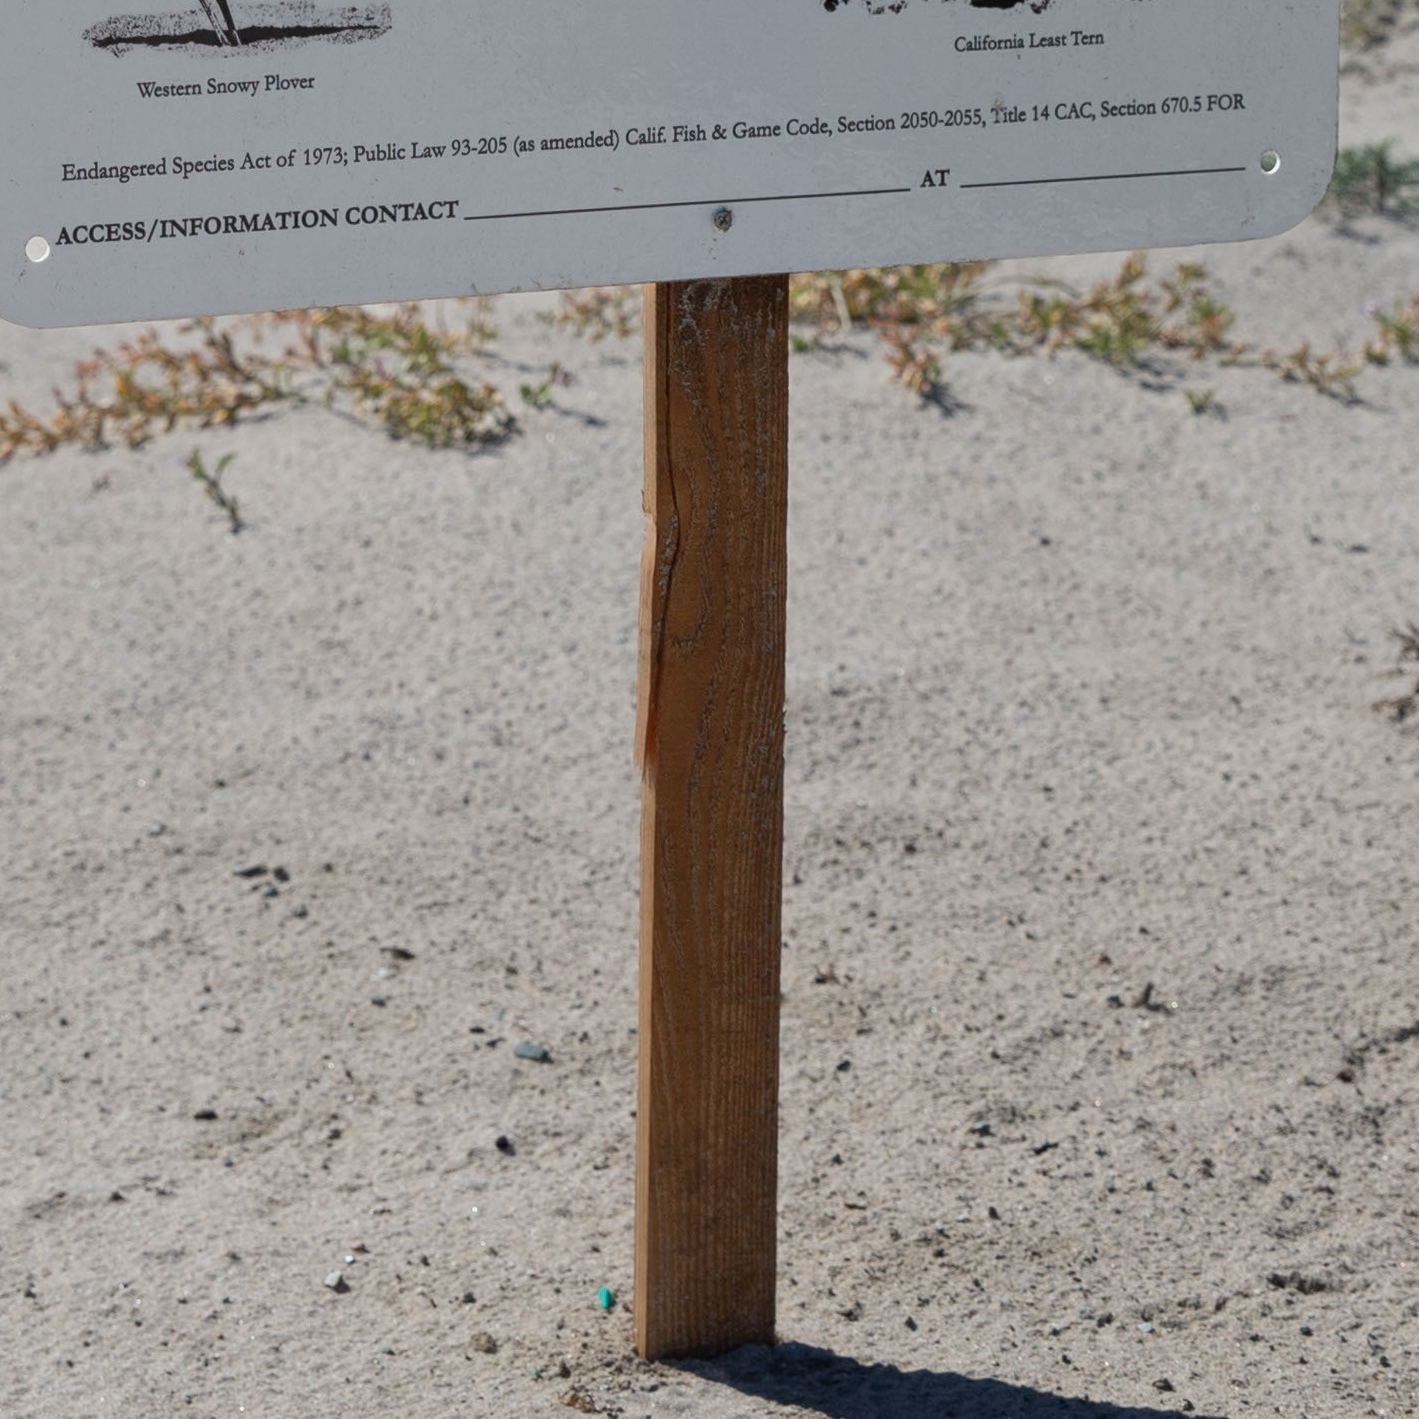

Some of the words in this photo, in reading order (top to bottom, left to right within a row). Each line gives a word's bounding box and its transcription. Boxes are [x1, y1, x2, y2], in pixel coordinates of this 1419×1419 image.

[954, 33, 1025, 53] California
[1028, 32, 1068, 49] Least
[1070, 30, 1105, 47] Tern
[136, 81, 203, 99] Western
[206, 77, 260, 97] Snowy
[264, 74, 316, 92] Plover
[61, 157, 168, 184] Endangered
[172, 154, 235, 180] Species
[239, 151, 272, 170] Act
[275, 148, 297, 168] of
[303, 146, 349, 167] 1973;
[353, 142, 406, 163] Public
[410, 141, 447, 159] Law
[451, 136, 508, 157] 93-205
[513, 135, 536, 158] (as
[540, 128, 620, 152] amended)
[625, 125, 667, 146] Calif.
[672, 124, 707, 143] Fish
[711, 123, 728, 141] &
[732, 121, 782, 139] Game
[786, 117, 833, 138] Code,
[837, 114, 896, 133] Section
[900, 108, 987, 130] 2050-2055,
[990, 105, 1027, 125] Title
[1032, 104, 1051, 122] 14
[1054, 101, 1096, 122] CAC,
[1100, 100, 1157, 118] Section
[1160, 95, 1202, 114] 670.5
[1206, 93, 1246, 112] FOR
[55, 208, 339, 246] ACCESS/INFORMATION
[345, 199, 460, 226] CONTACT
[919, 168, 951, 188] AT
